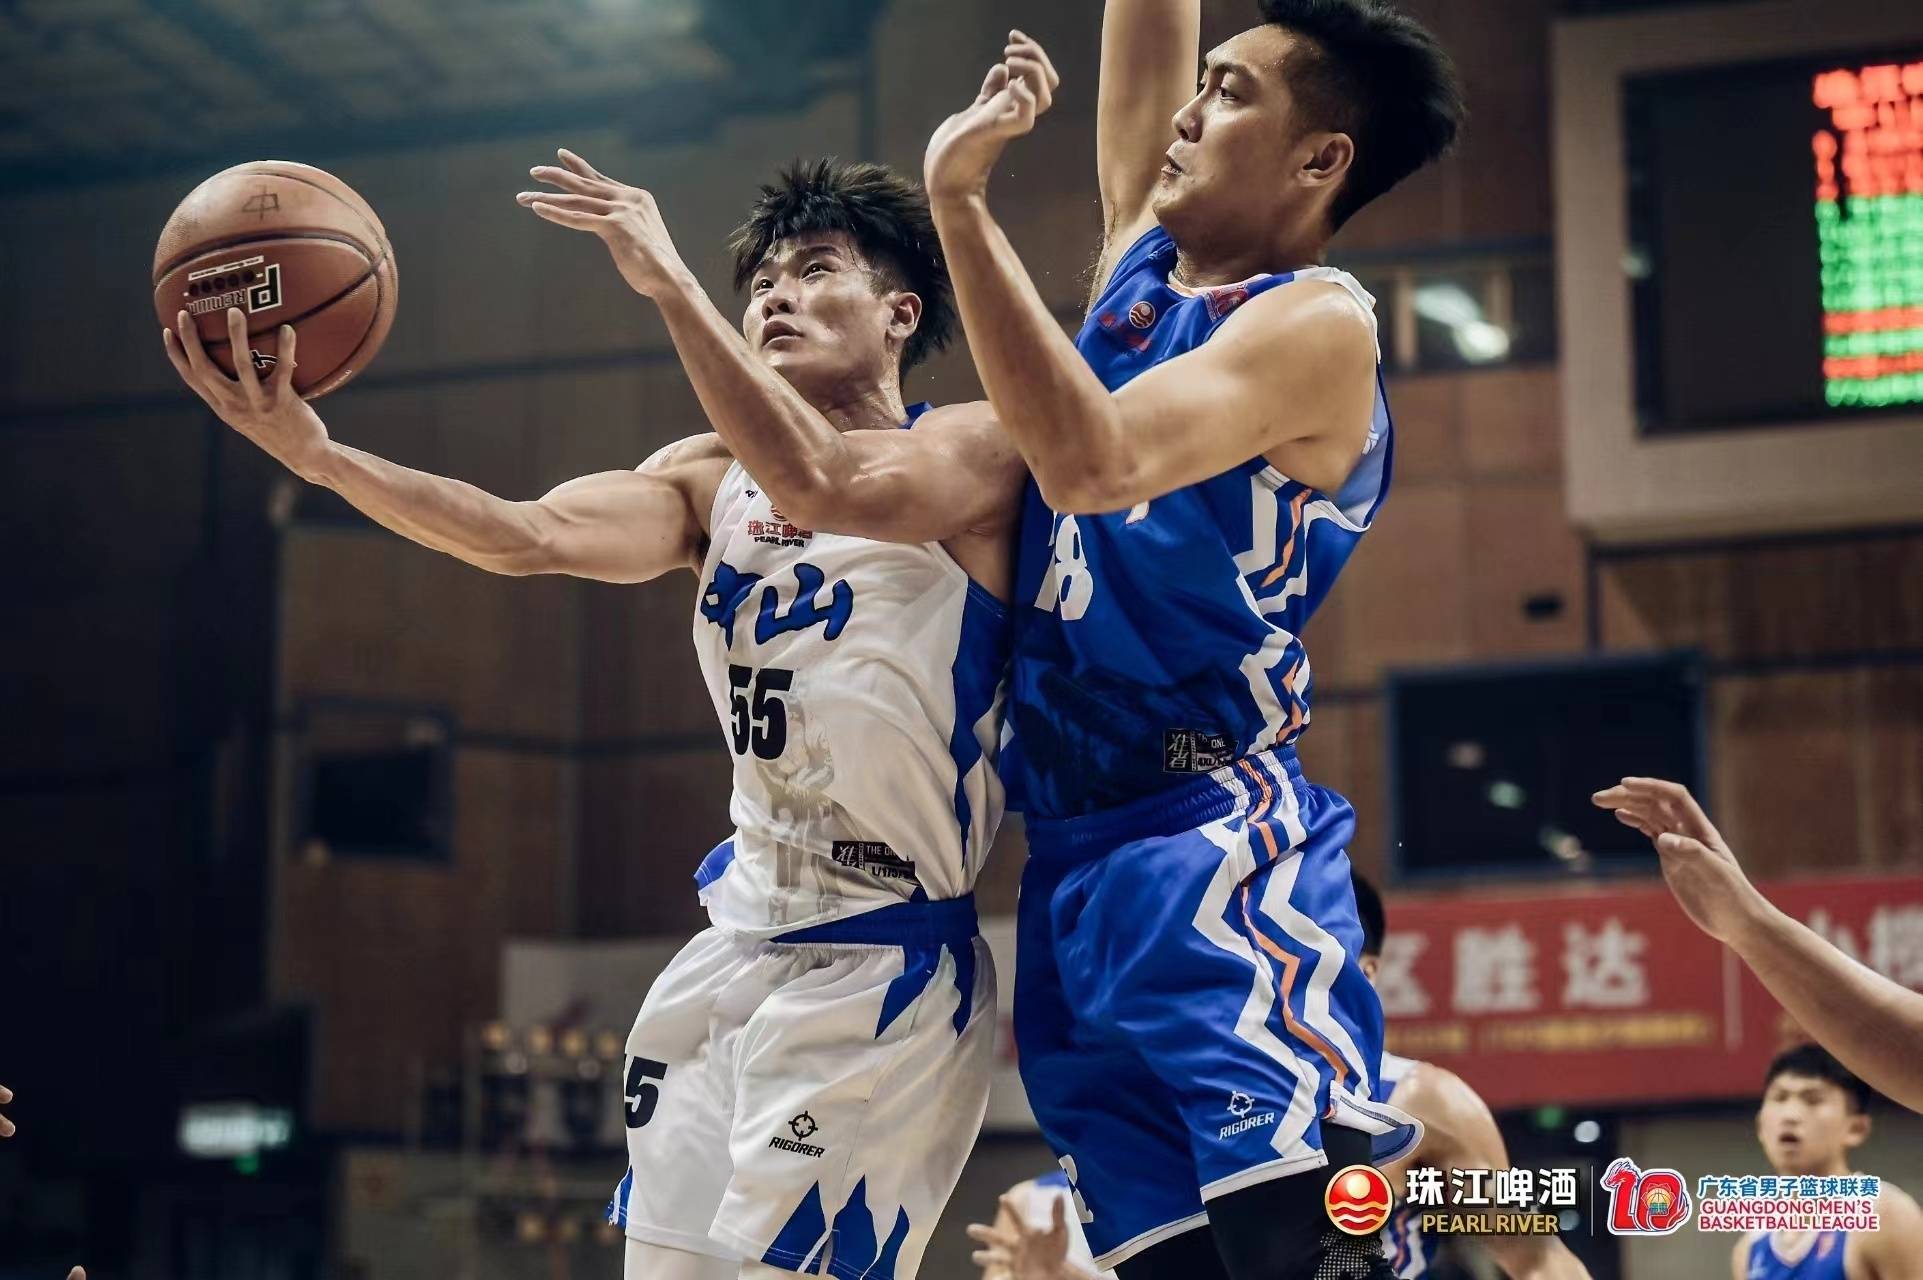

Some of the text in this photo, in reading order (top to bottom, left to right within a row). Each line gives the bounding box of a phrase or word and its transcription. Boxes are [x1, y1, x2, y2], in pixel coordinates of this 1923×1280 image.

[754, 536, 805, 548] PEARL RIVER
[728, 663, 794, 760] 55
[866, 845, 882, 855] THE
[1219, 1112, 1275, 1140] RIGORER
[769, 1136, 825, 1158] RIGORER
